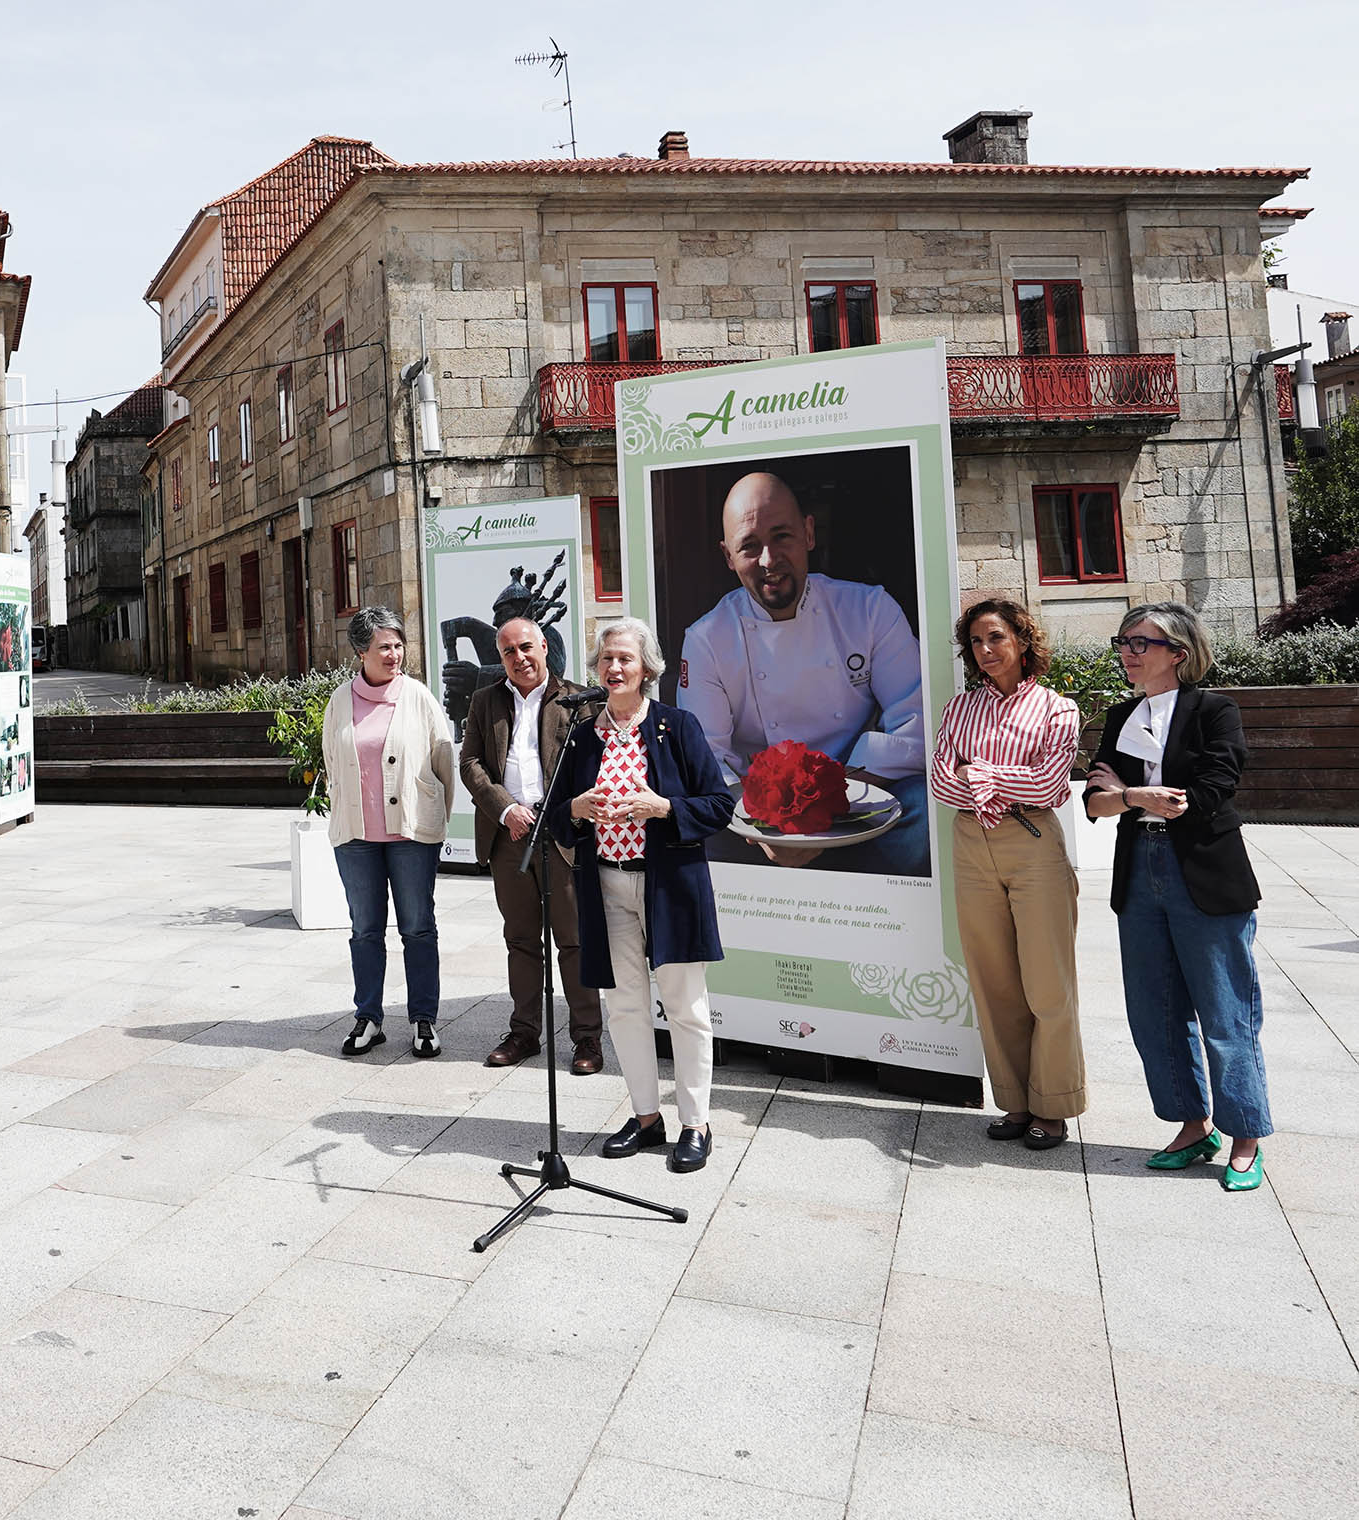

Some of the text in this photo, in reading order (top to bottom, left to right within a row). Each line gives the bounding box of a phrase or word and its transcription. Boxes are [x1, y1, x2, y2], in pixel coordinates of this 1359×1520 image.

[686, 380, 849, 438] A camelia
[741, 412, 848, 431] flor das galegas e galegos
[457, 513, 538, 540] A camelia
[798, 900, 817, 909] para
[819, 901, 840, 910] todos
[743, 908, 792, 920] pretendemos
[851, 920, 870, 928] nosa
[779, 1019, 798, 1032] SEC
[902, 1039, 959, 1052] INTERNATIONAL
[934, 1049, 958, 1057] SOCIETY
